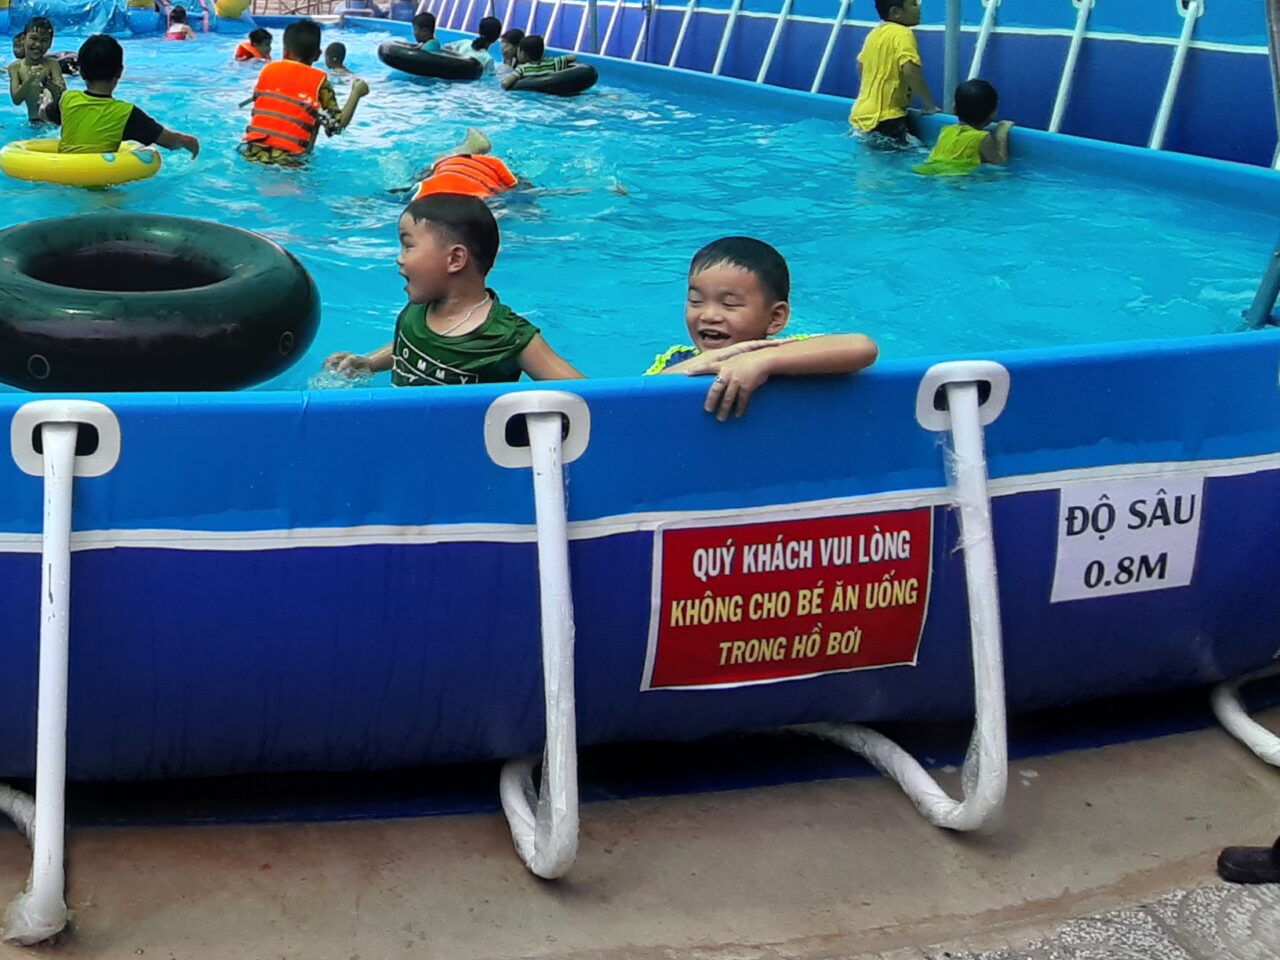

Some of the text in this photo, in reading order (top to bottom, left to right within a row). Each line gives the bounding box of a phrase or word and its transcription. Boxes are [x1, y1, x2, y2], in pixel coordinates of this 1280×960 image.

[1065, 488, 1196, 540] ĐỘ SÂU
[692, 525, 910, 582] QUÝ KHÁCH VUI LÒNG
[1084, 552, 1168, 588] 0.8M
[670, 569, 919, 627] KHÔNG CHO BÉ ĂN UỐNG
[719, 622, 862, 666] TRONG HỒ BƠI
